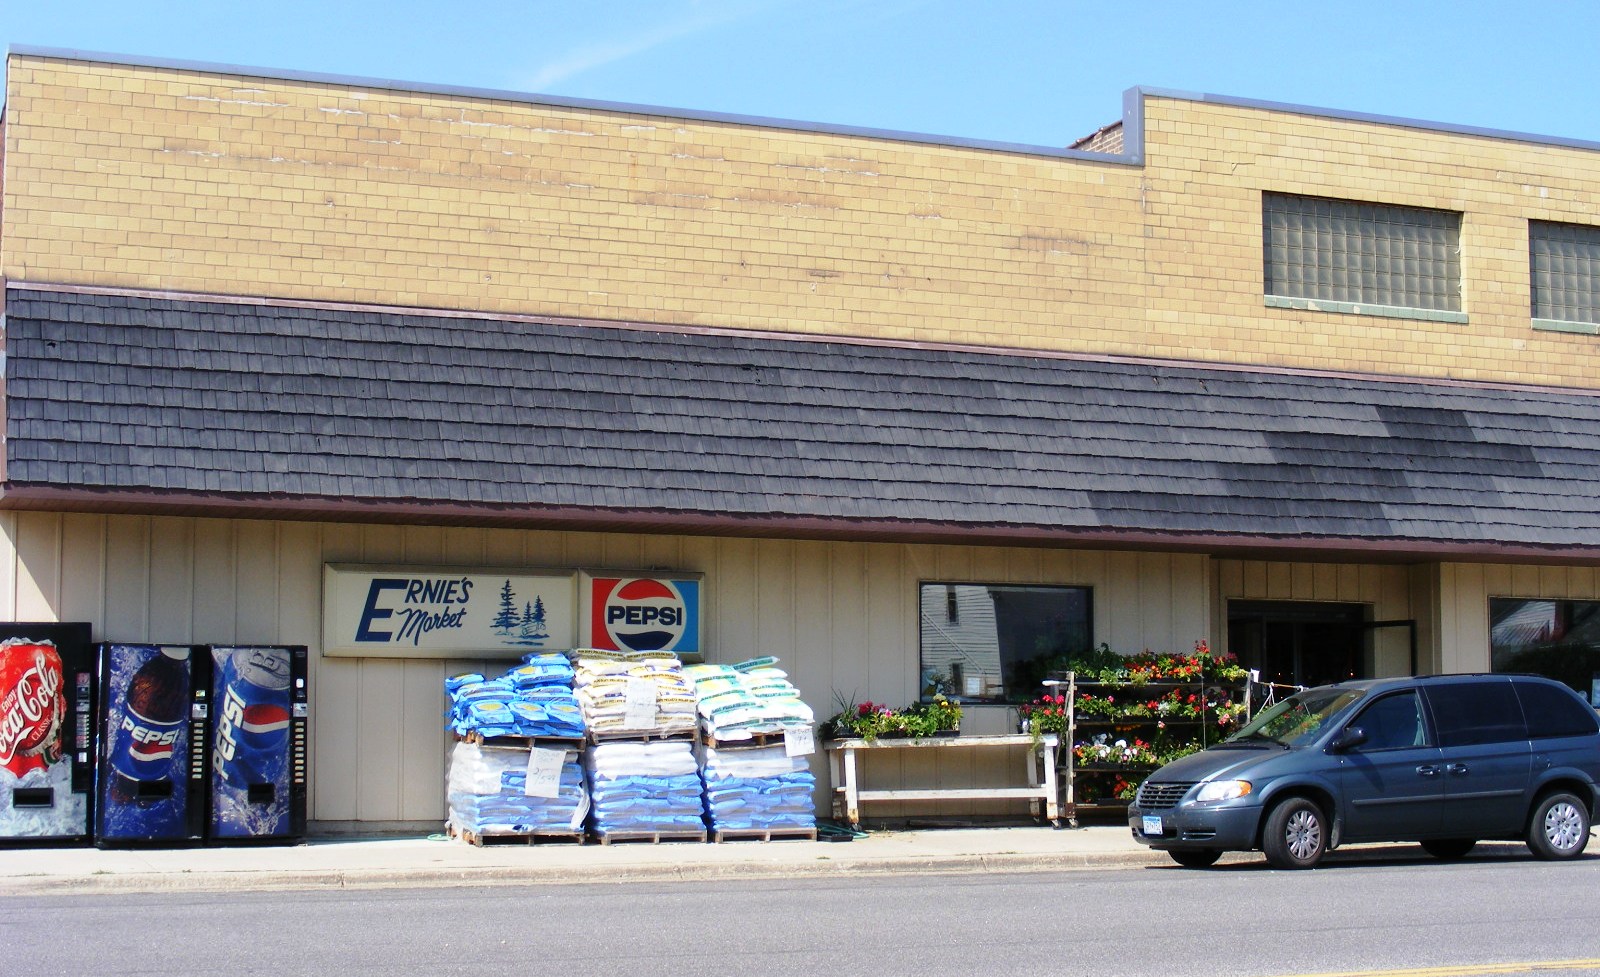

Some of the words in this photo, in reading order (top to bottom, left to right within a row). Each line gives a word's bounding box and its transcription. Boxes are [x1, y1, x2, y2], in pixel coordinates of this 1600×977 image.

[355, 577, 473, 642] ERNIE'S
[396, 606, 467, 646] Market
[607, 605, 683, 626] PEPSI
[0, 650, 59, 766] oca-Cola
[1, 689, 17, 712] Enjoy
[31, 715, 52, 741] CLASSIC
[121, 715, 180, 746] PEPSI
[213, 683, 246, 781] PEPSI
